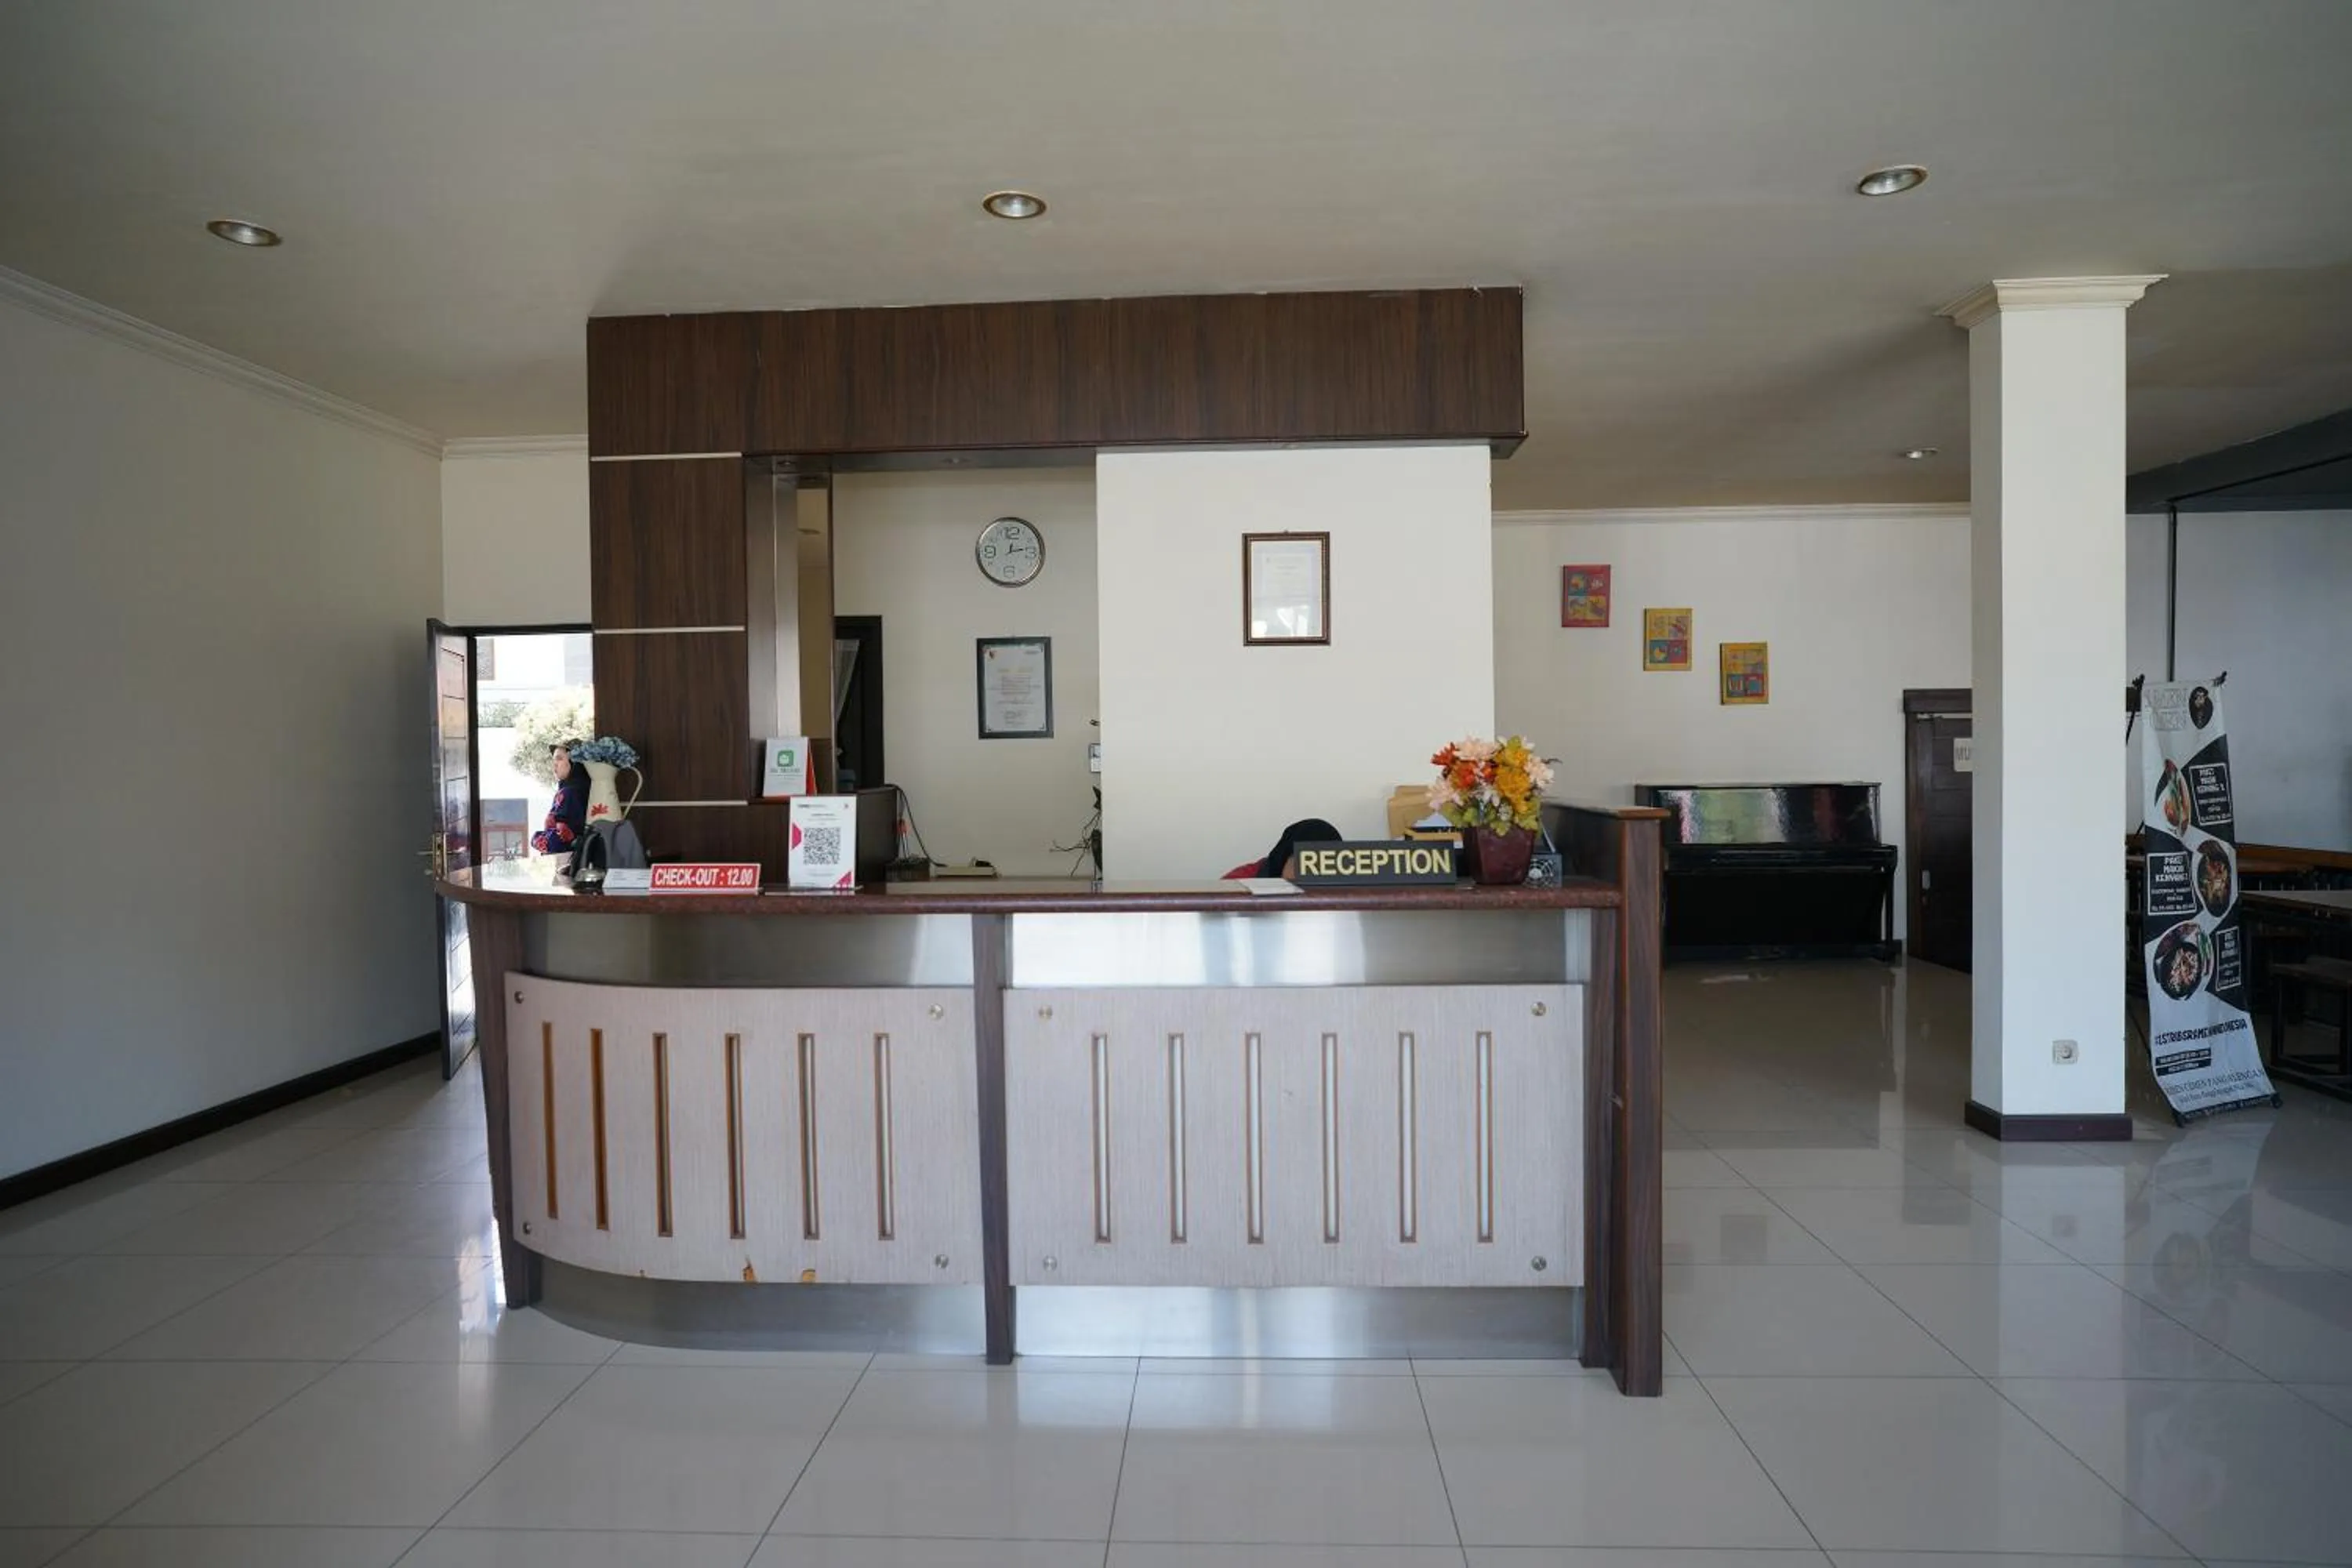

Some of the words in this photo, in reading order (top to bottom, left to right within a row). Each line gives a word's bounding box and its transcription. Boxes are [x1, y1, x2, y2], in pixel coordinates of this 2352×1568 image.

[984, 545, 996, 559] 9
[1298, 848, 1451, 876] RECEPTION
[655, 868, 720, 887] CHECK-OUT
[727, 868, 753, 886] 12.00
